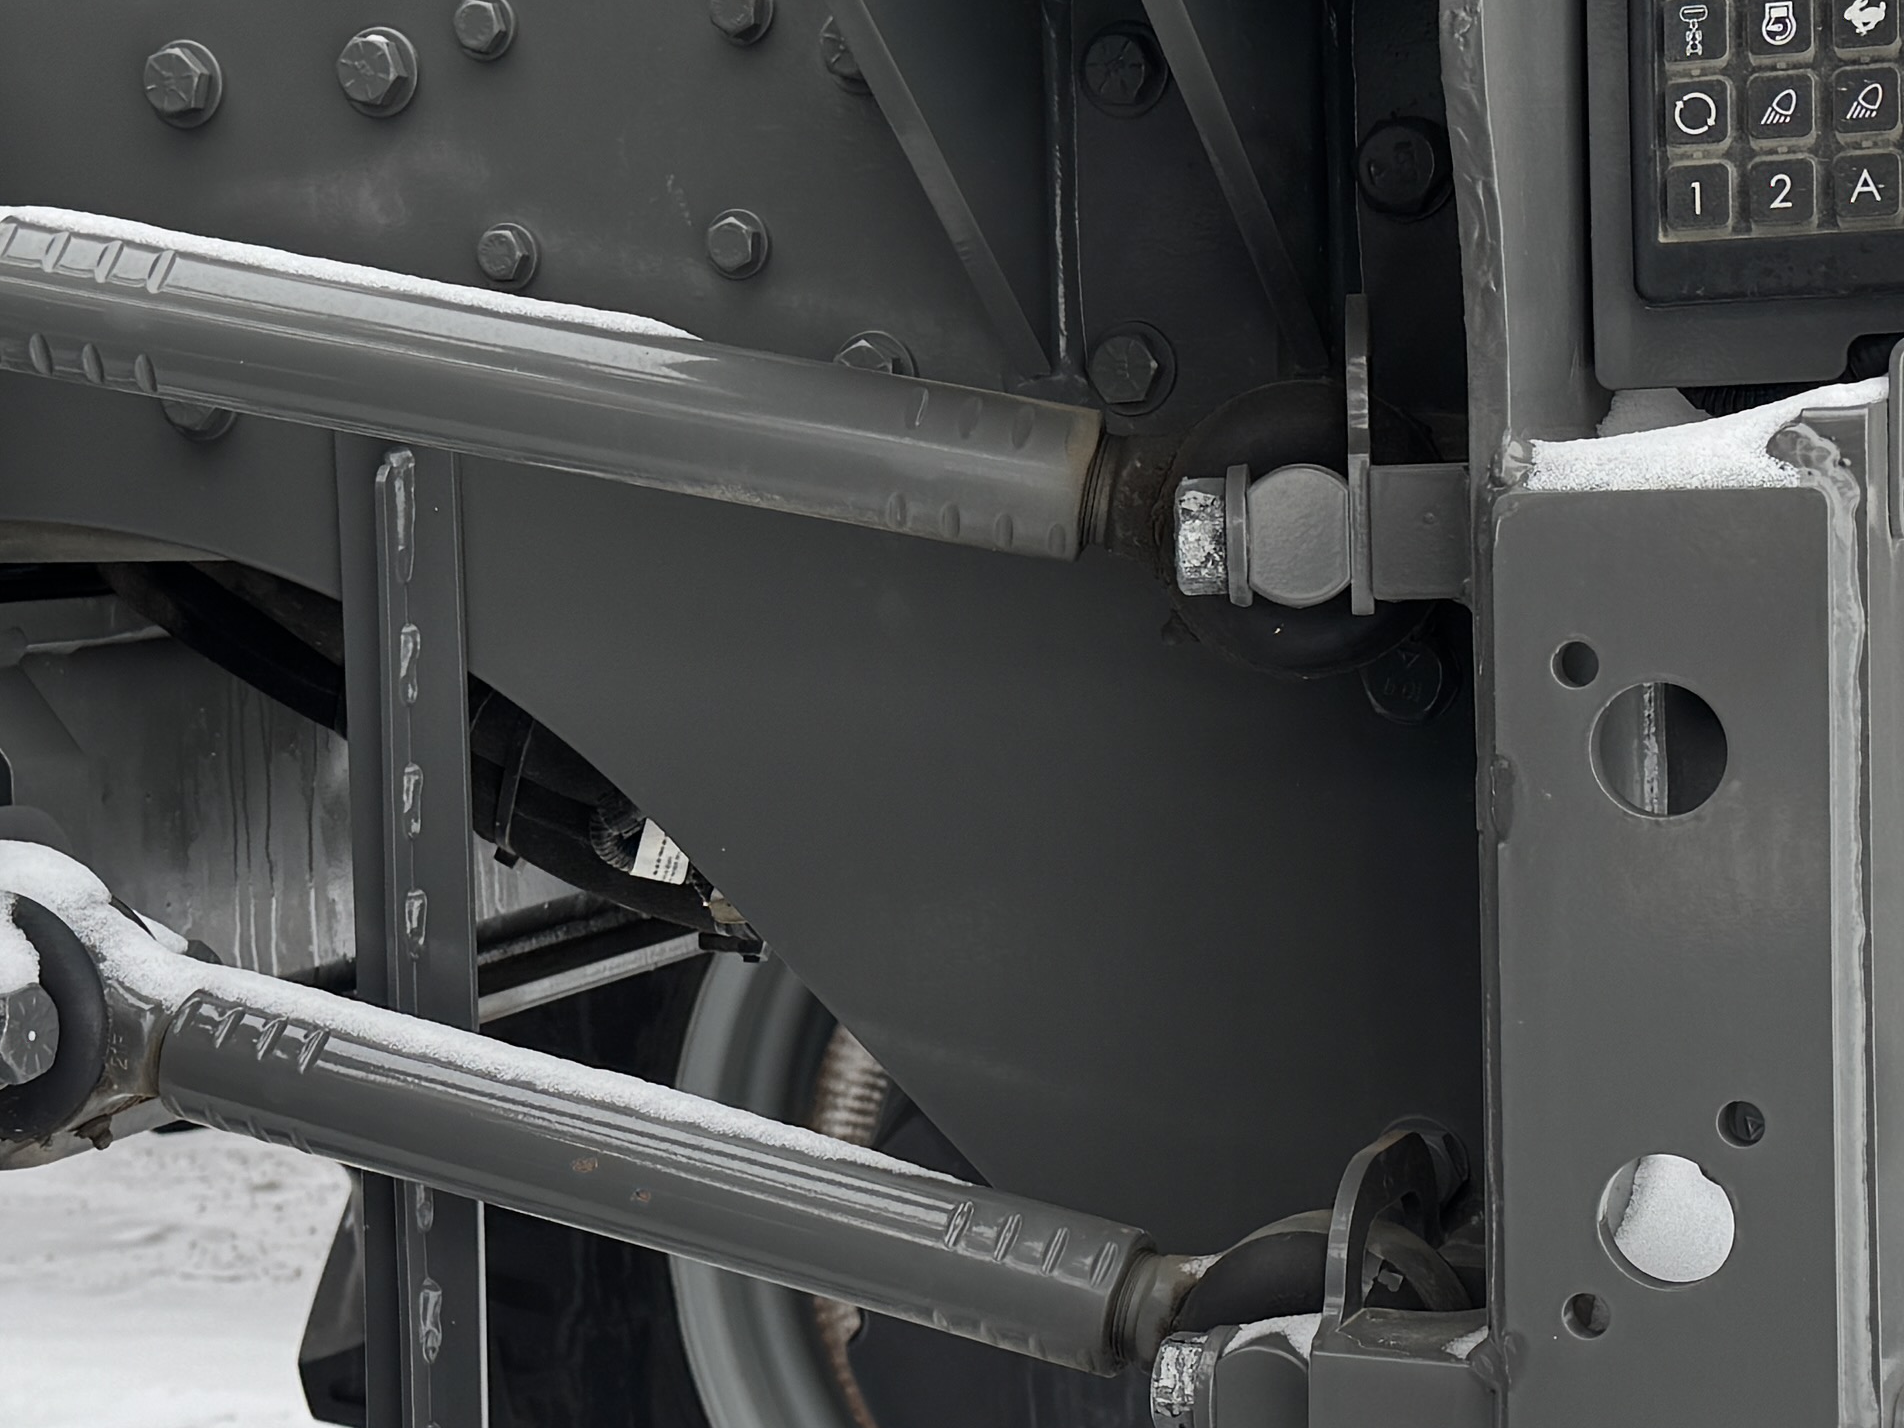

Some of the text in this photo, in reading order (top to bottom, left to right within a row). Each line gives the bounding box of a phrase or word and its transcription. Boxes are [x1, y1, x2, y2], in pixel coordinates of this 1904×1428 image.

[1688, 180, 1703, 216] 1
[1768, 172, 1794, 210] 2
[1849, 167, 1883, 205] A
